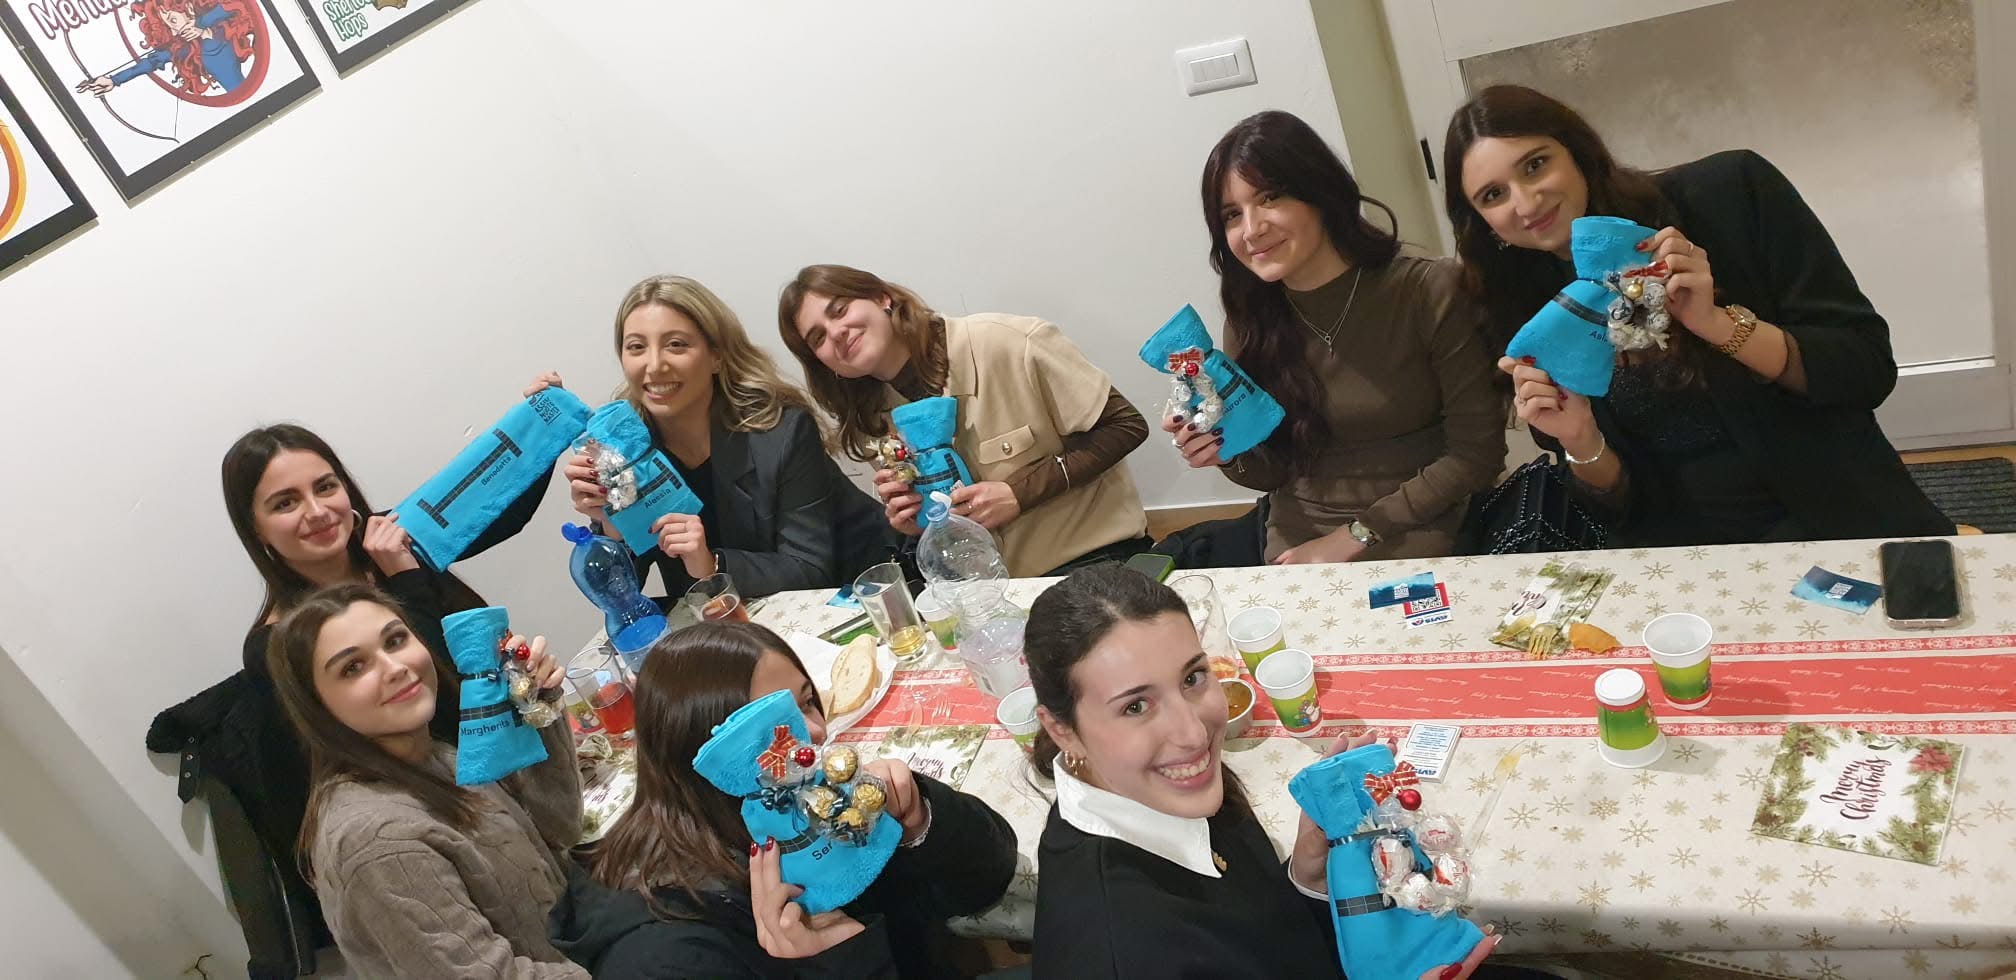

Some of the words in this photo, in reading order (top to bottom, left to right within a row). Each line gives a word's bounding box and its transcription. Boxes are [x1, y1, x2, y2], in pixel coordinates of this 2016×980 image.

[332, 13, 369, 42] Hops
[1224, 393, 1247, 414] urora
[1840, 756, 1893, 820] Christmas
